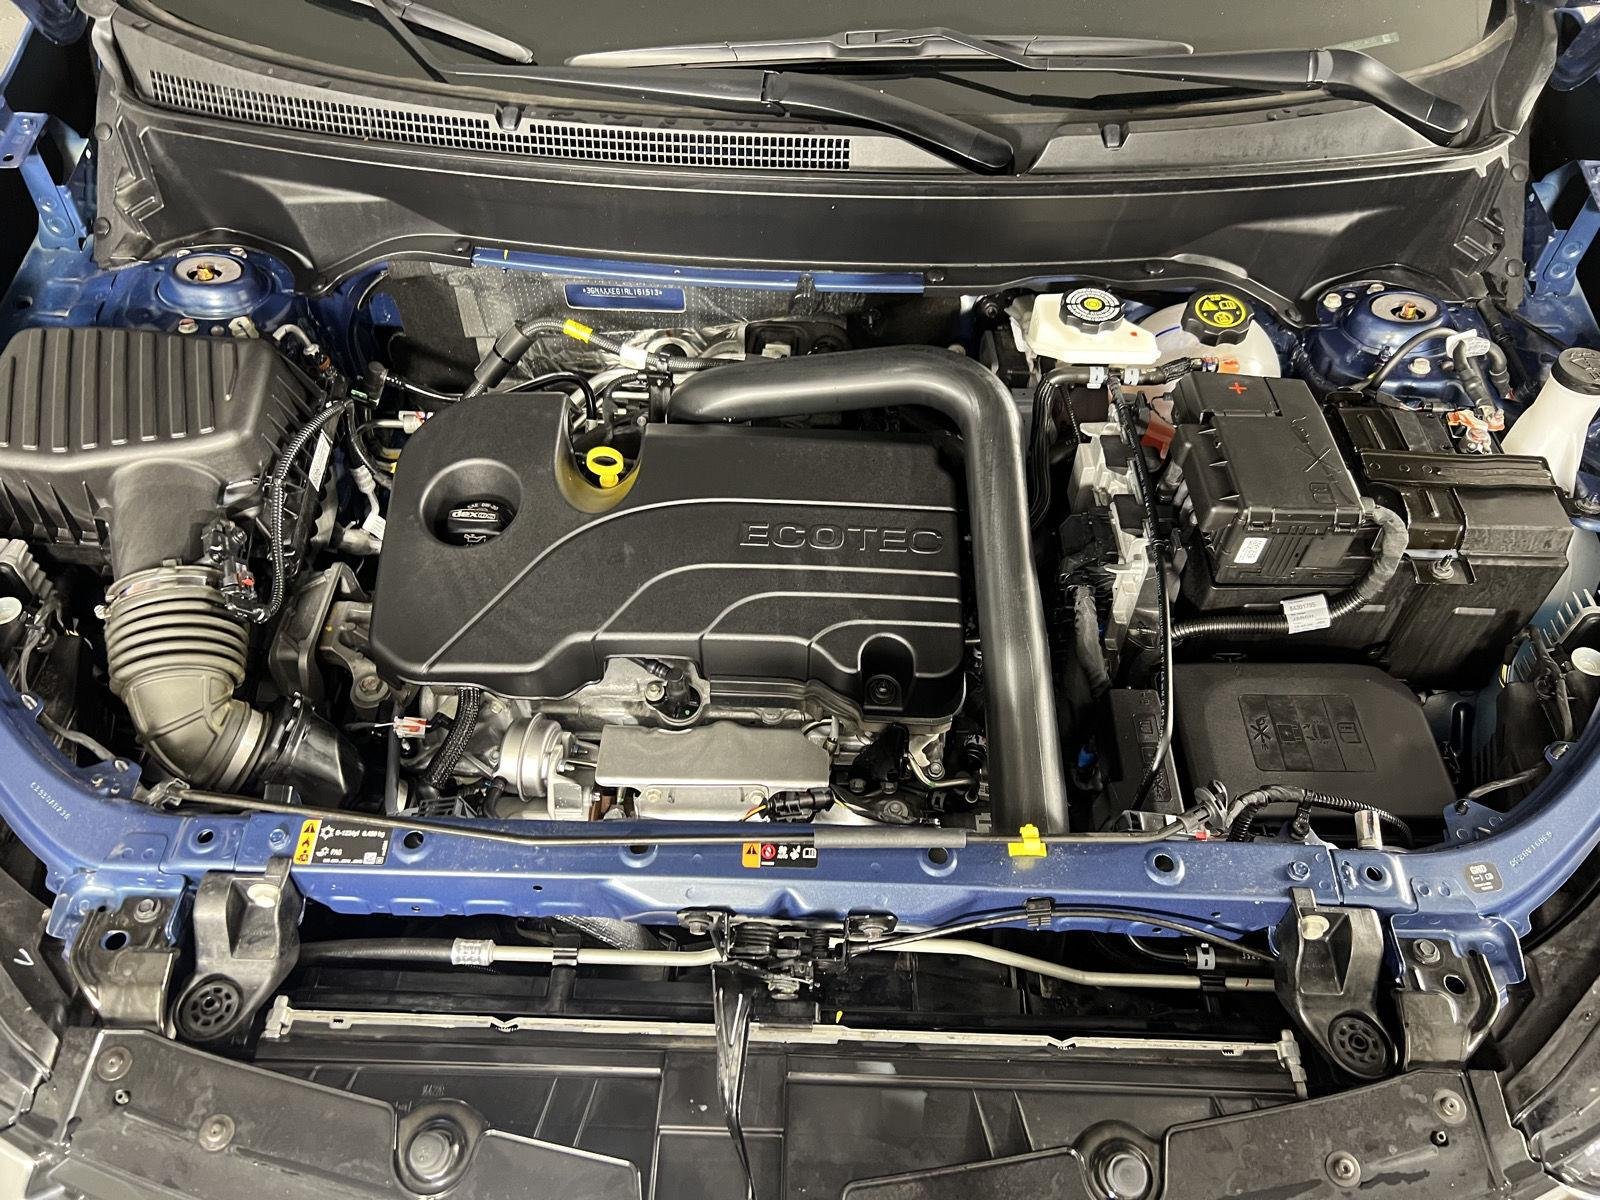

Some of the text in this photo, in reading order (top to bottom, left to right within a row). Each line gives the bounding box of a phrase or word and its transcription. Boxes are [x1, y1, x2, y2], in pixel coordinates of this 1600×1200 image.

[451, 510, 496, 520] dexos
[739, 521, 945, 555] ECOTEC
[330, 848, 343, 856] PAG
